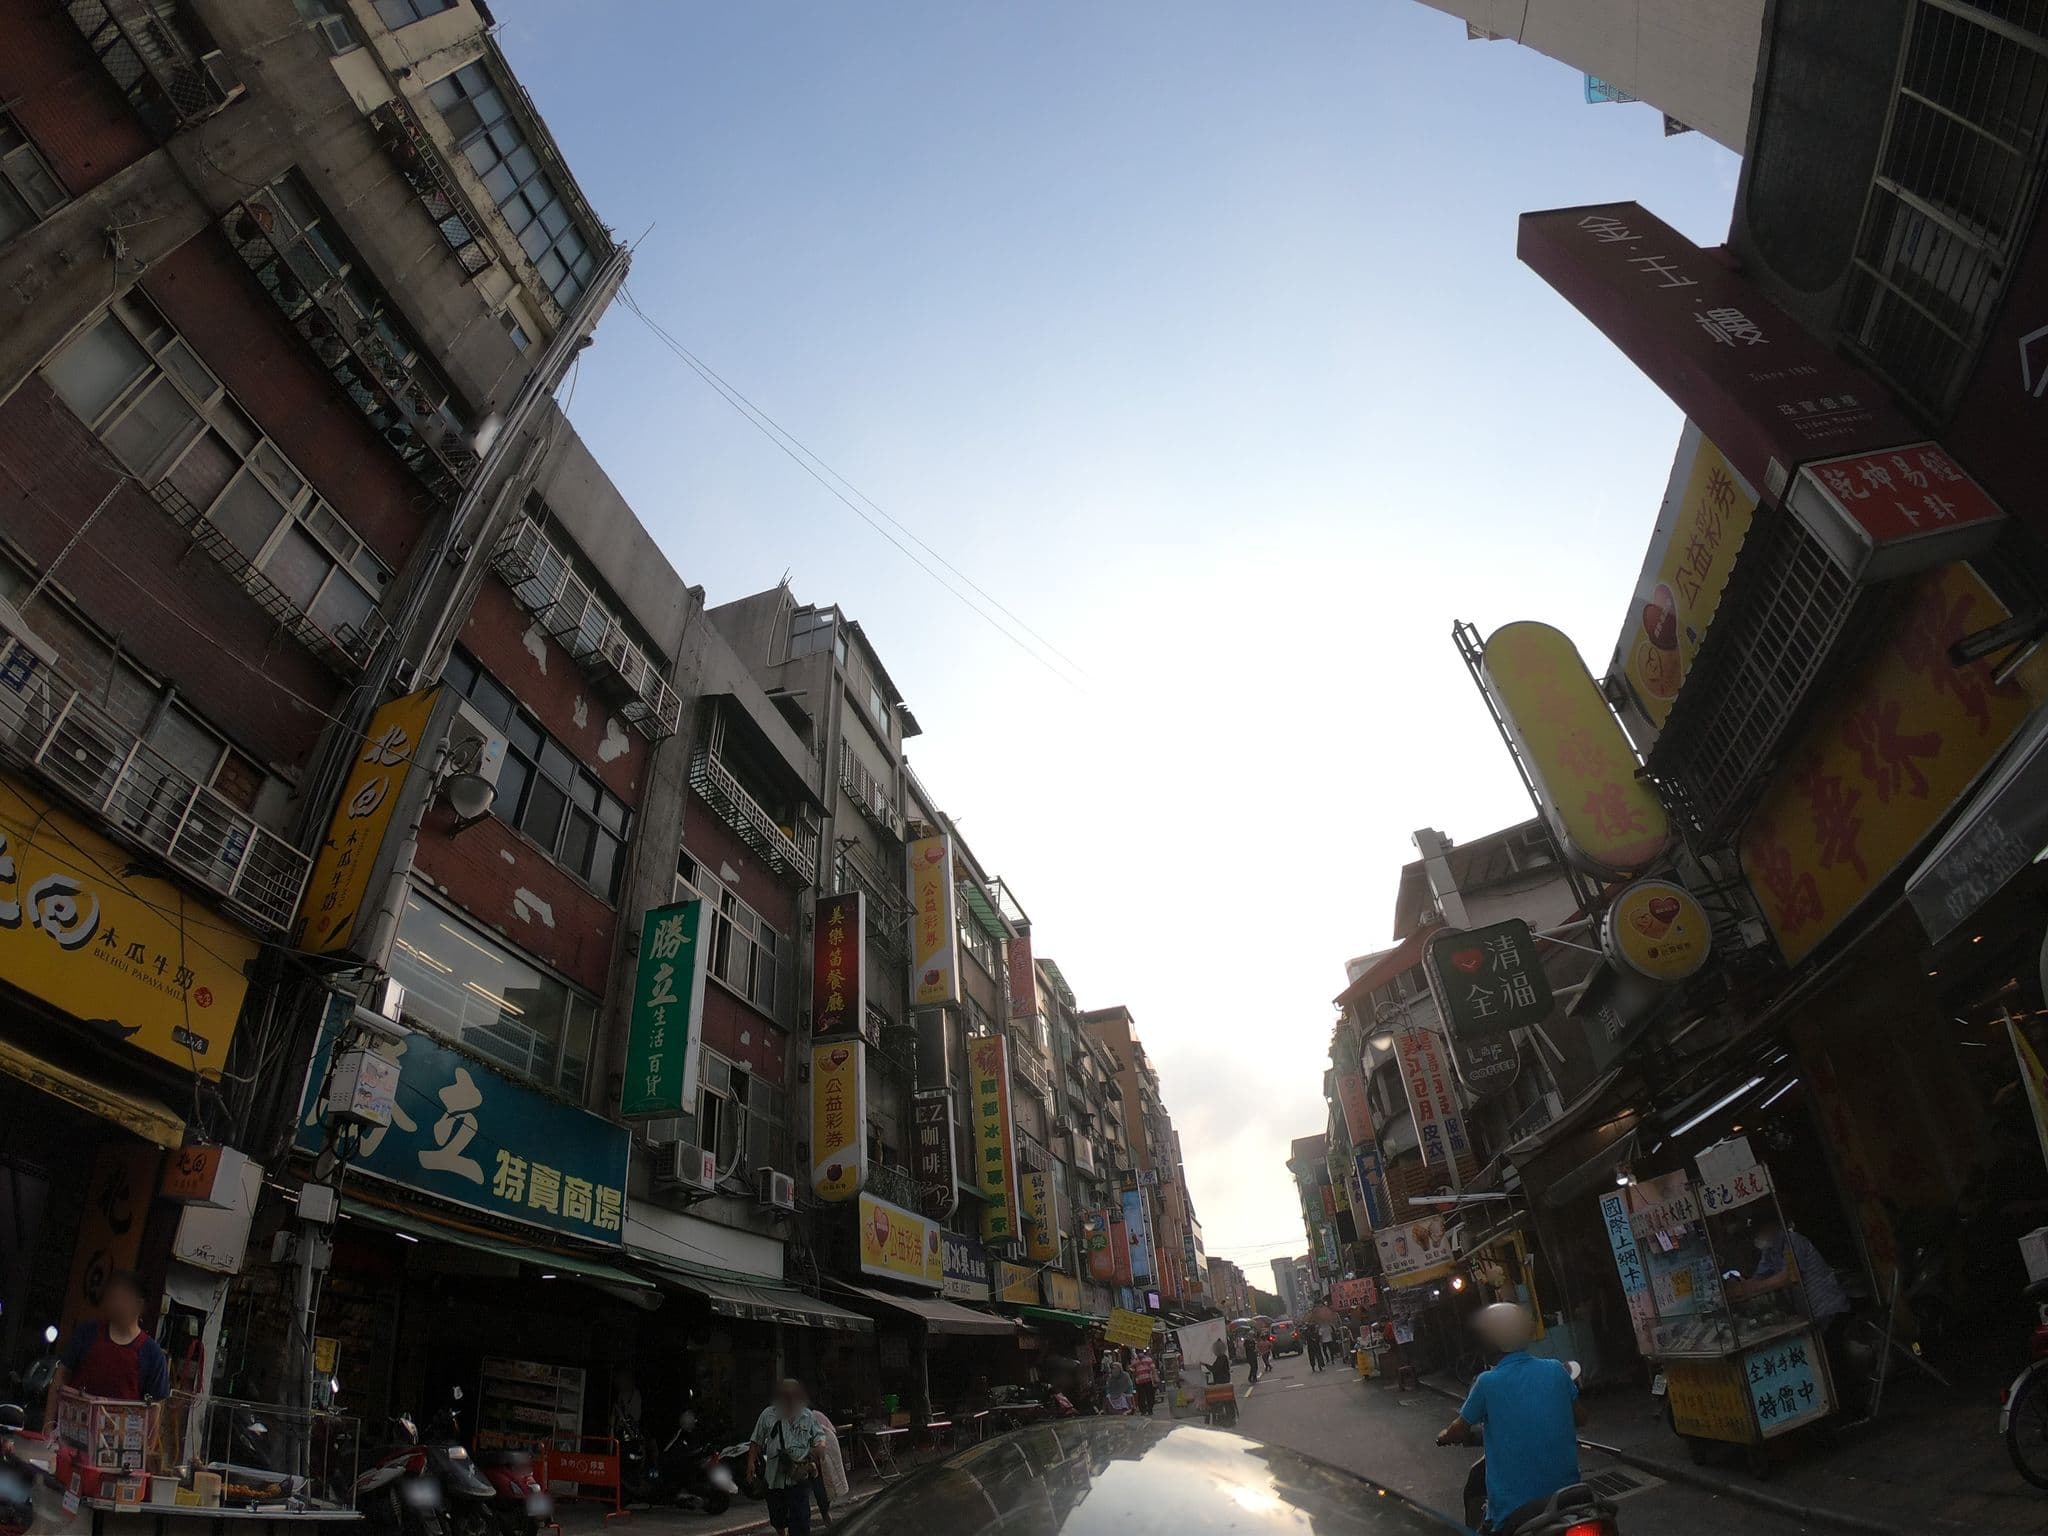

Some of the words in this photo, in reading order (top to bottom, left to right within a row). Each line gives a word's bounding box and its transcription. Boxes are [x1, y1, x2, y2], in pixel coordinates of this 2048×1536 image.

[1822, 451, 1967, 499] 乾坤易經
[1675, 467, 1736, 609] 公益彩券
[1896, 493, 1958, 526] 卜卦
[320, 827, 359, 912] 木瓜牛奶
[921, 882, 938, 946] 公益彩券
[98, 926, 195, 990] 木瓜牛奶
[646, 913, 692, 1007] 勝立
[1484, 935, 1521, 971] 清
[647, 1007, 667, 1097] 生活百貨
[1470, 1058, 1516, 1080] COFFEE
[824, 1079, 844, 1148] 公益彩券
[921, 1126, 939, 1174] 咖啡
[492, 1148, 622, 1232] 特賣商場
[889, 1223, 922, 1266] 公益彩券
[1603, 1196, 1641, 1284] 國際上網卡
[1750, 1345, 1809, 1385] 全新手機
[1758, 1380, 1815, 1420] 特價中
